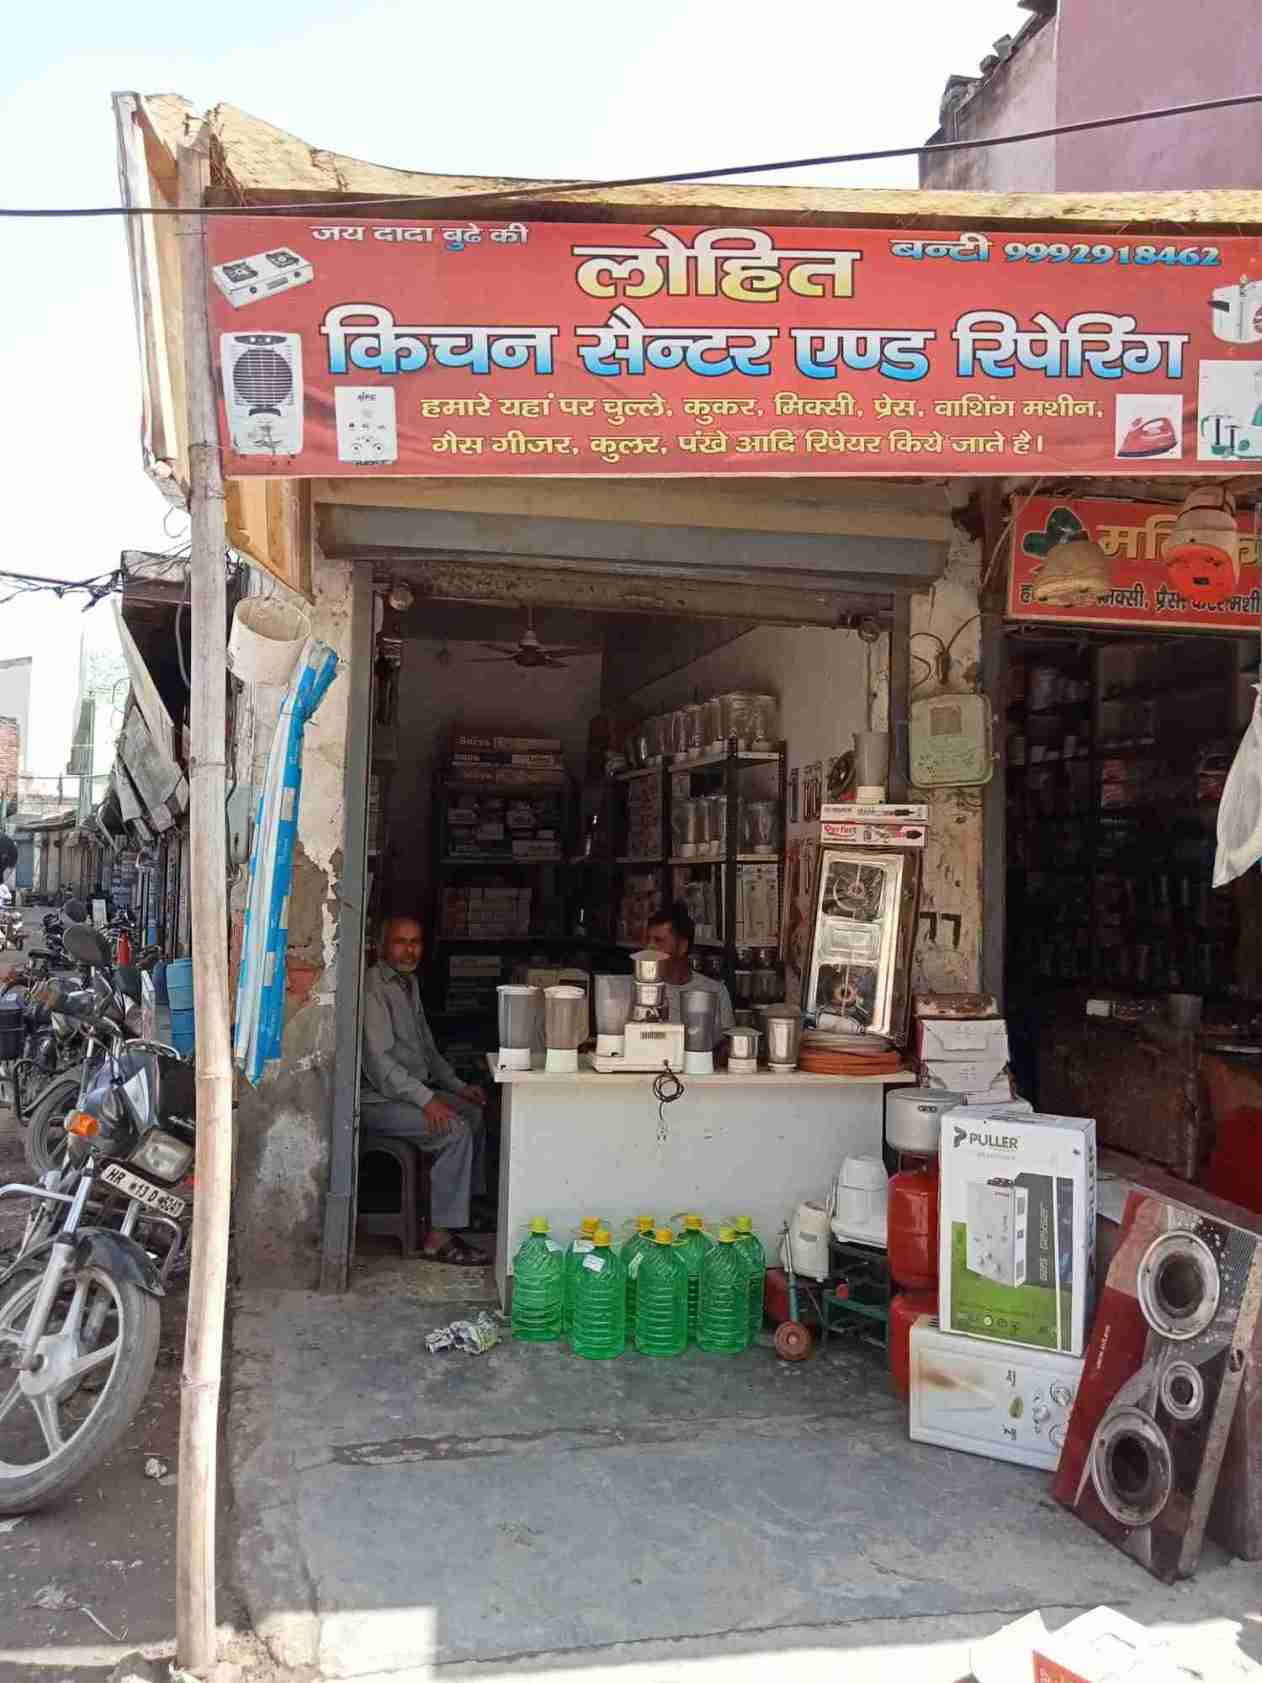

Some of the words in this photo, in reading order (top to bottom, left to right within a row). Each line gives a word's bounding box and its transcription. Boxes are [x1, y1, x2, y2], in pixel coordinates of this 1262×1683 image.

[309, 225, 366, 241] जय
[373, 226, 434, 243] दादा
[490, 222, 529, 244] की
[889, 231, 992, 262] बन्टी
[1004, 242, 1222, 266] 9992918462
[571, 226, 863, 302] लोहित
[320, 303, 560, 375] किचन
[575, 303, 779, 378] सैन्टर
[790, 328, 936, 381] एण्ड
[952, 309, 1190, 379] रिपेरिंग
[420, 392, 492, 417] हमारे
[498, 392, 555, 417] यहां
[559, 399, 597, 416] पर
[934, 393, 1016, 417] वाशिंग
[678, 430, 729, 454] पंखे
[735, 429, 796, 453] आदि
[804, 429, 883, 453] रिपेयर
[887, 429, 944, 453] किये
[950, 431, 1006, 454] जाते
[969, 1132, 1018, 1150] PULLER
